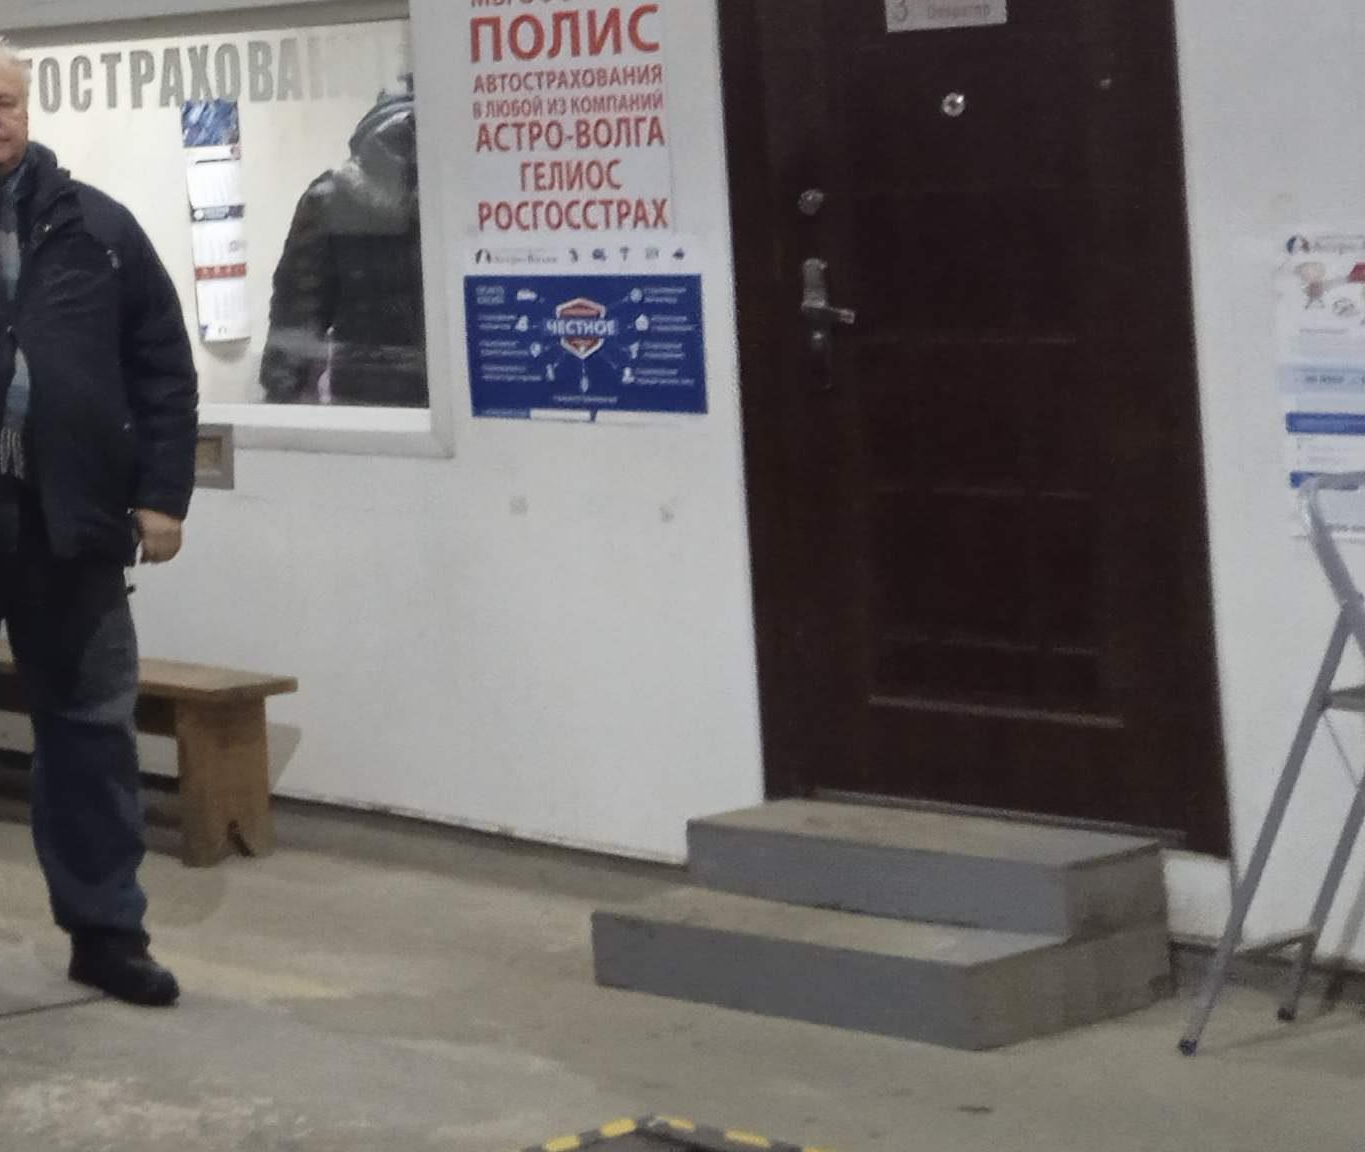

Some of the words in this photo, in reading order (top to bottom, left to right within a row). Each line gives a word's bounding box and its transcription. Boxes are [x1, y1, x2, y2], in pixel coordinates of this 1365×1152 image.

[470, 3, 661, 64] ПОЛИС
[24, 37, 321, 114] ОСТРАХОВА
[472, 63, 663, 94] АВТОСТРАХОВАНИЯ
[472, 102, 482, 119] В
[485, 96, 543, 118] ЛЮБОЙ
[547, 98, 568, 115] ИЗ
[570, 90, 664, 114] КОМПАНИЙ
[475, 115, 666, 152] АСТРО-ВОЛГА
[520, 159, 623, 192] ГЕЛИОС
[477, 197, 669, 231] РОСГОССТРАХ
[545, 319, 615, 336] ЧЕСТНОЕ
